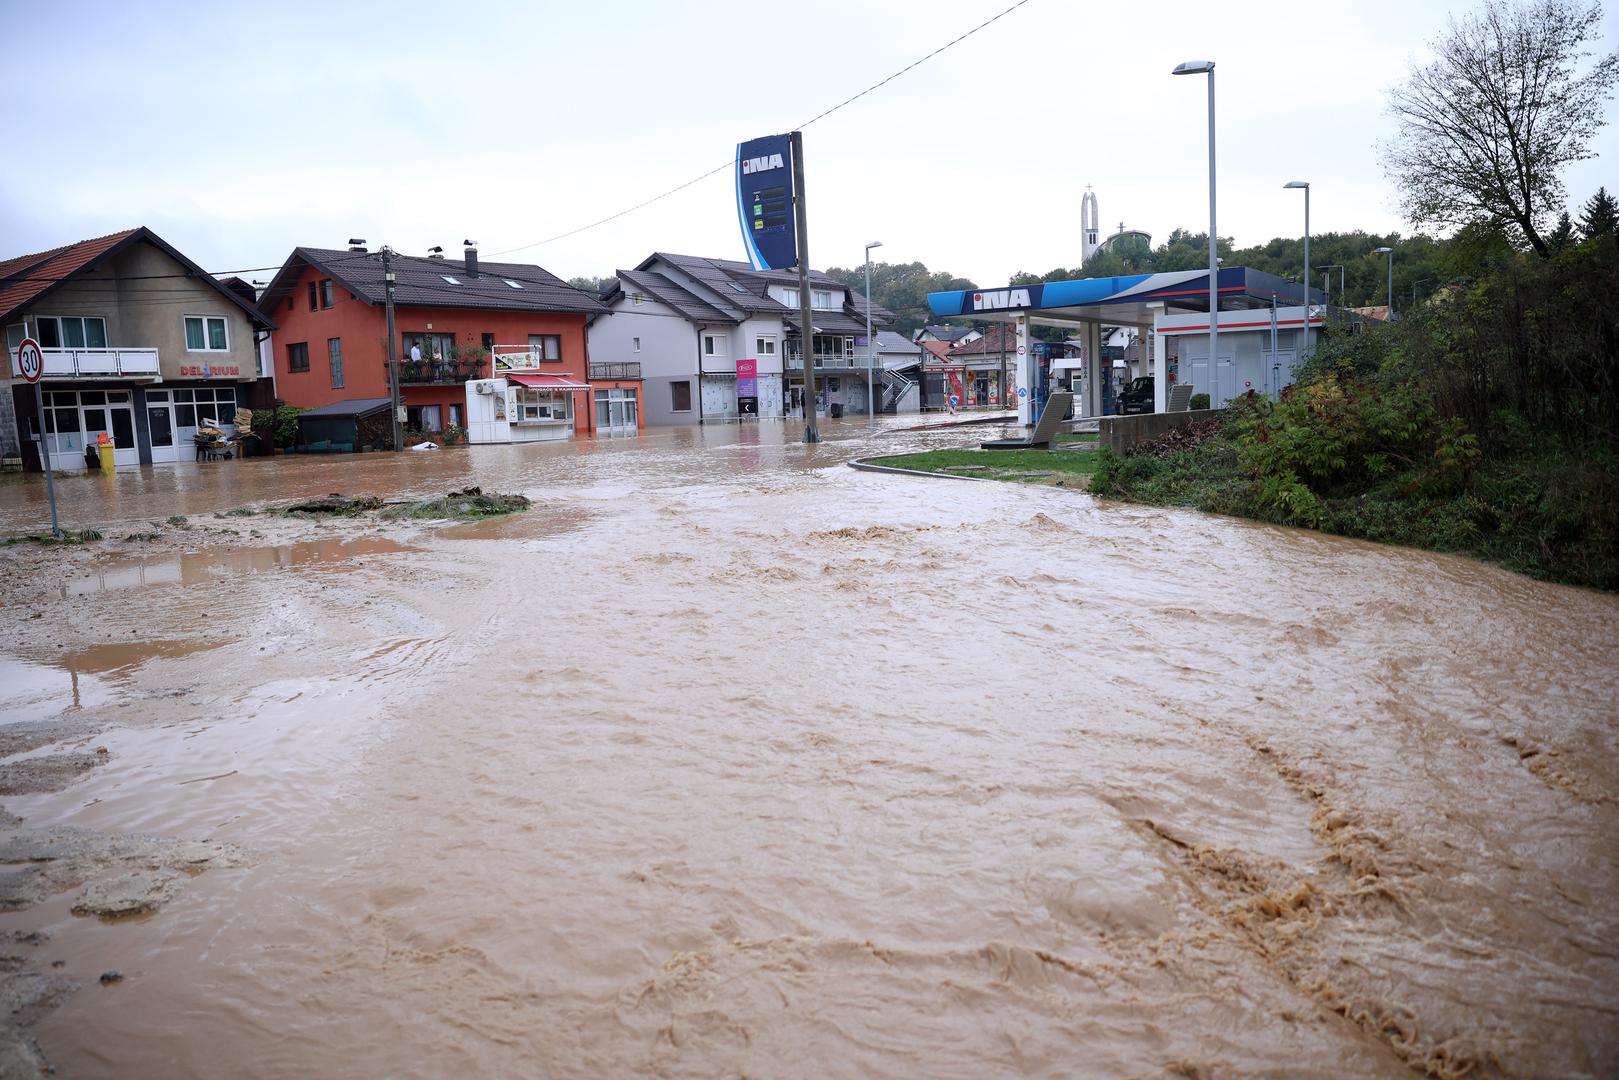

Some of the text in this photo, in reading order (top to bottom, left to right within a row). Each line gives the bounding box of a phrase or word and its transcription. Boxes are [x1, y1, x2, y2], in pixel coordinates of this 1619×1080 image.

[742, 153, 785, 175] INA
[973, 288, 1032, 311] INA
[22, 349, 38, 373] 30
[180, 364, 240, 377] DELIRIUM
